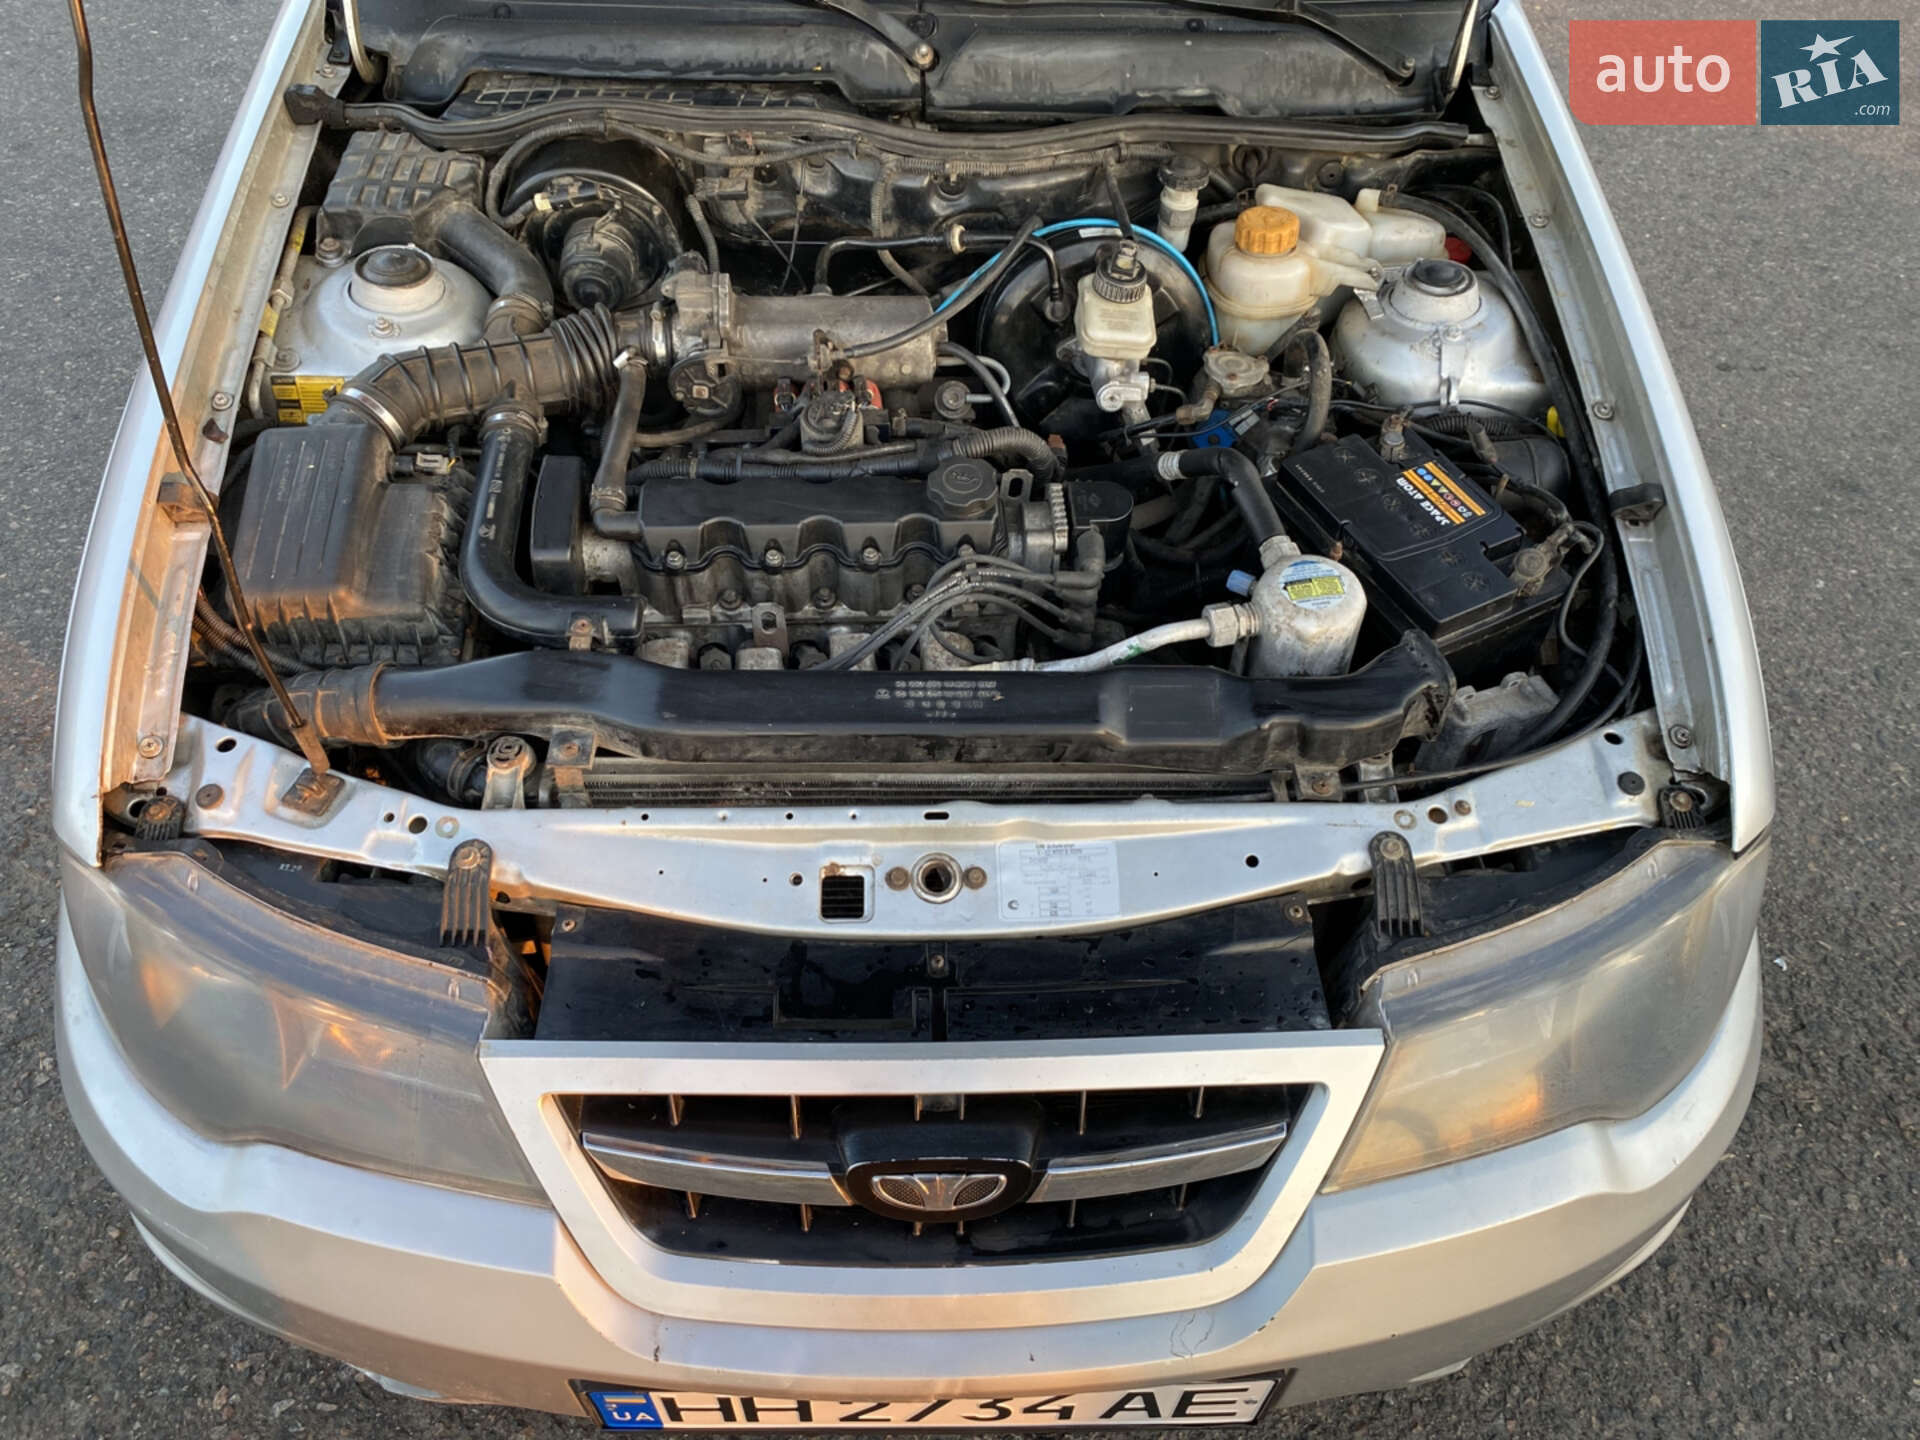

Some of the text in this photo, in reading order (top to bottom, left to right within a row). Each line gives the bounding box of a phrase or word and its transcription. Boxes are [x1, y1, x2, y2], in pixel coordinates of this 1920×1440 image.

[1396, 477, 1424, 500] ATOM
[1099, 1388, 1249, 1419] AE
[612, 1411, 655, 1421] UA
